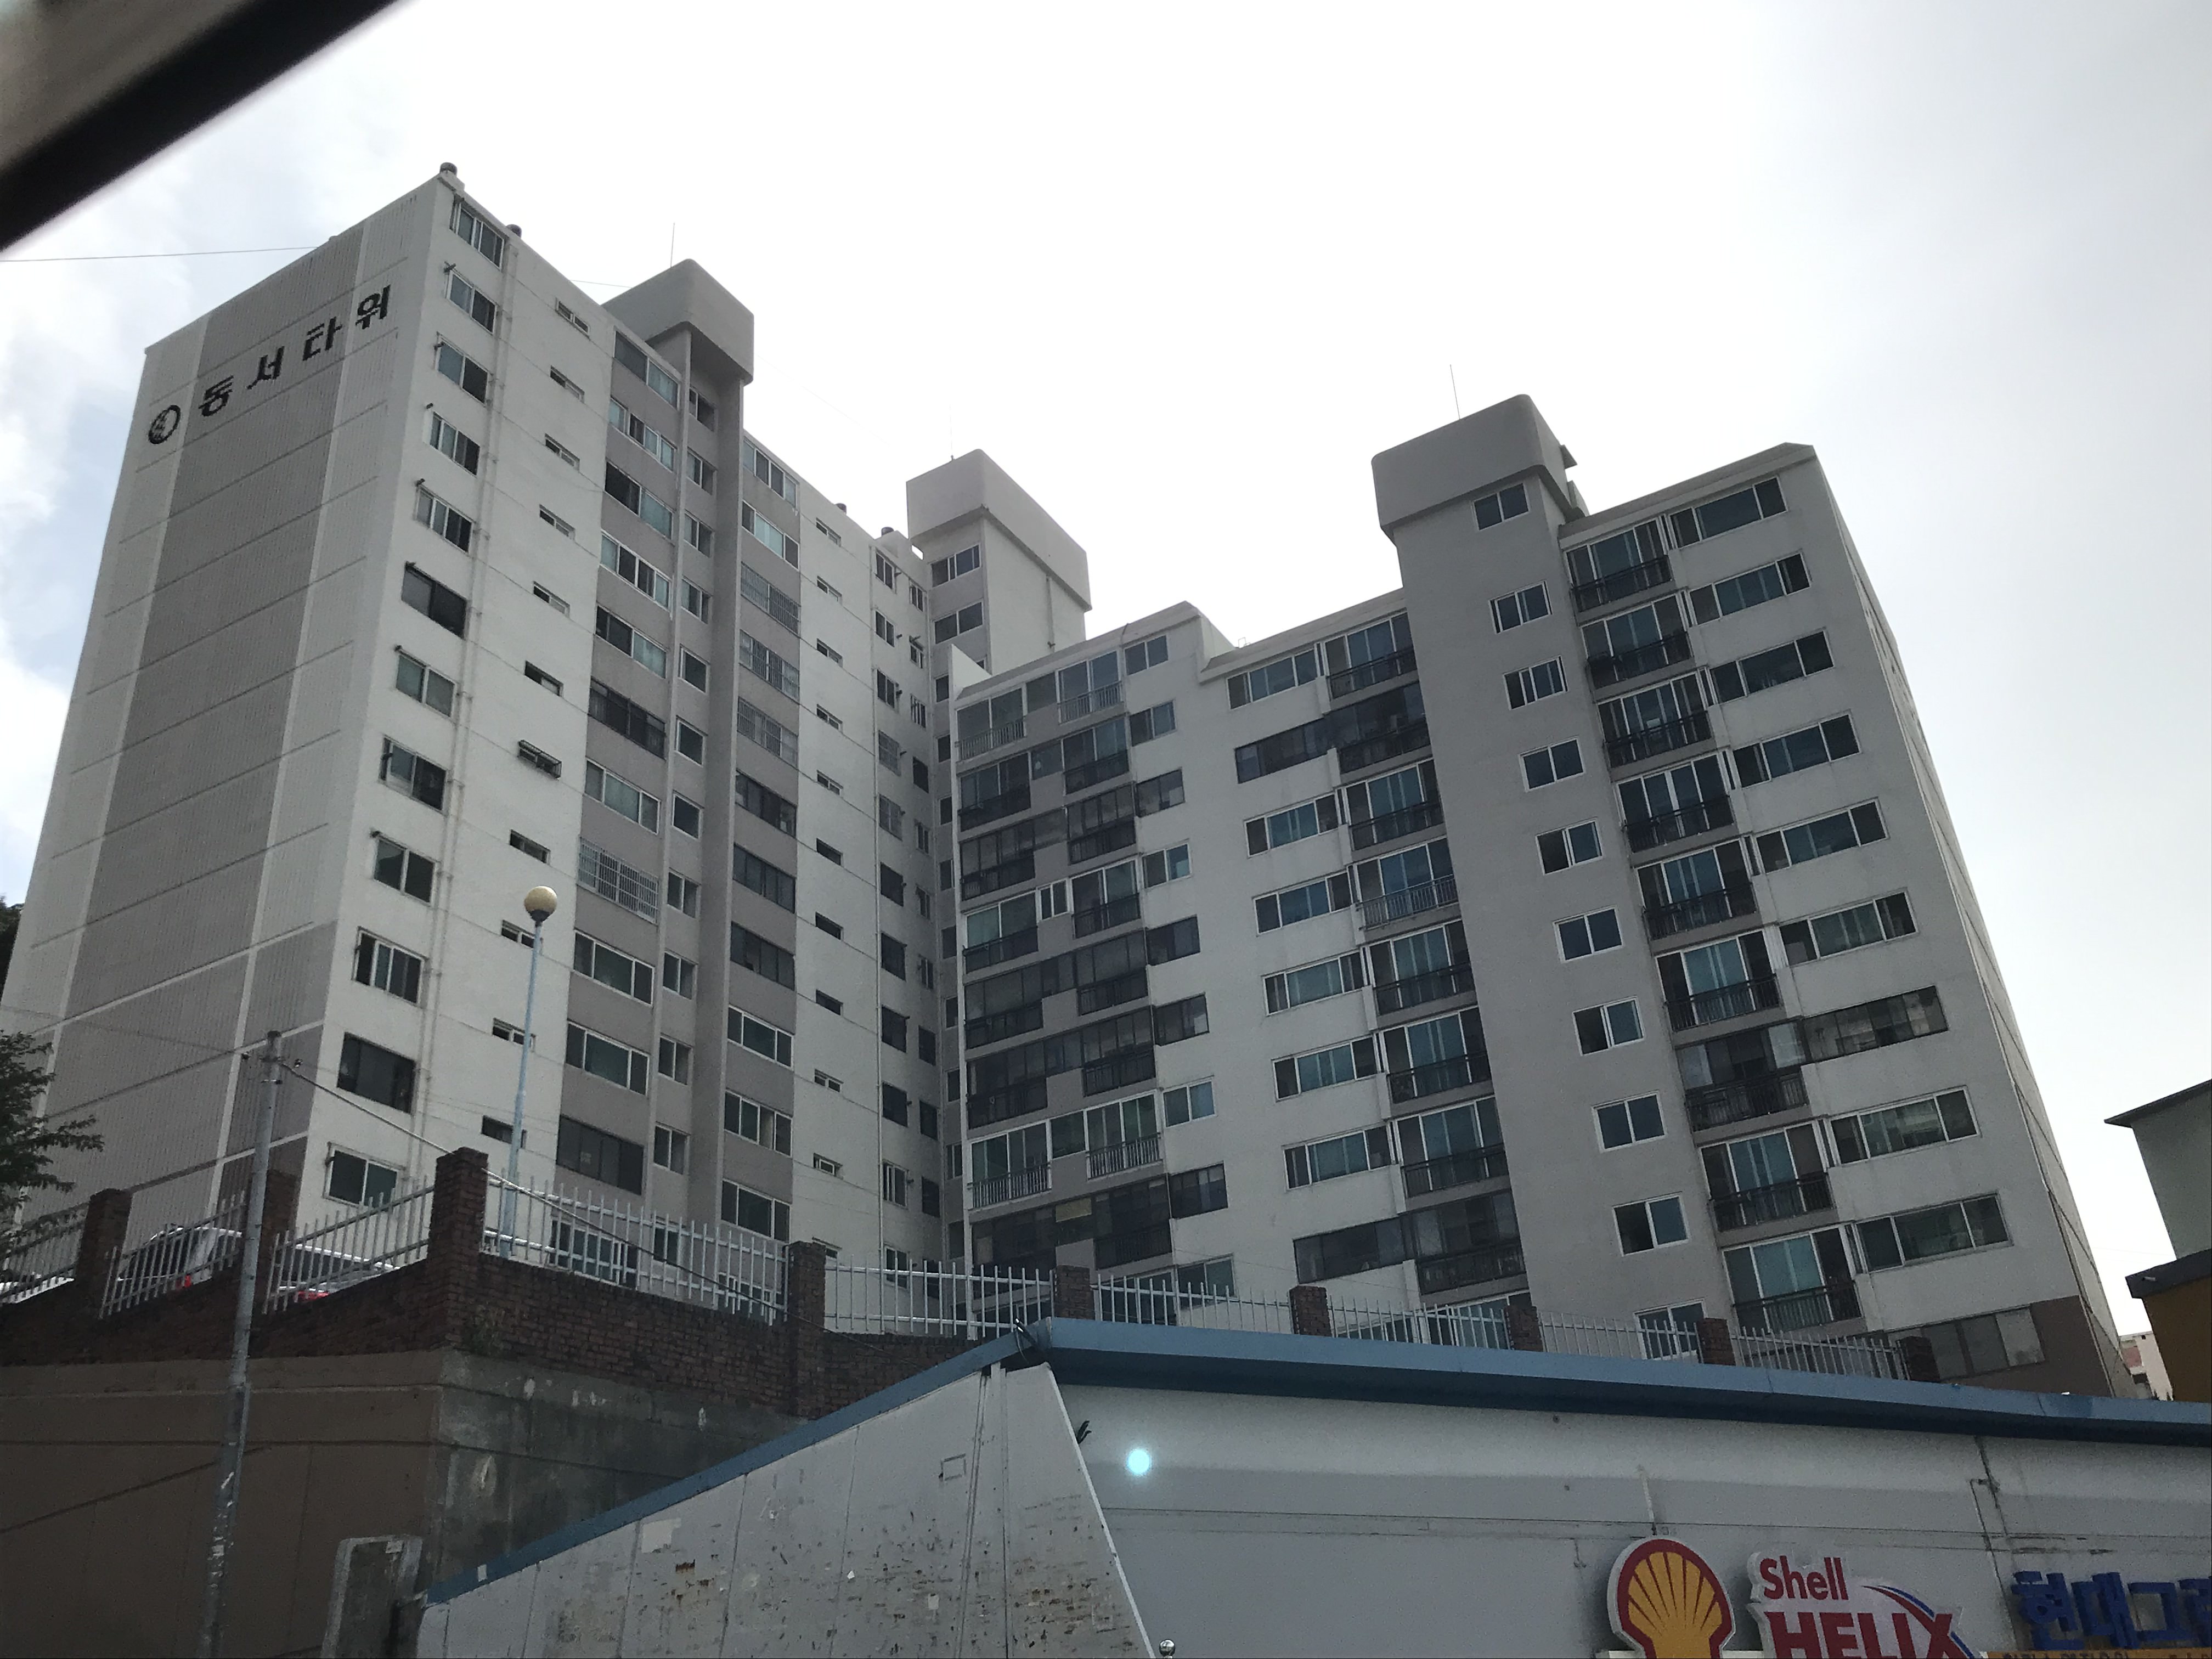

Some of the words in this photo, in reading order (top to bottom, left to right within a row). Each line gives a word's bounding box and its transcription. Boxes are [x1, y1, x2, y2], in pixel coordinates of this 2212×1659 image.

[199, 284, 391, 417] 동서타워
[1759, 1555, 1849, 1600] Shell
[1763, 1611, 1968, 1659] HELIX
